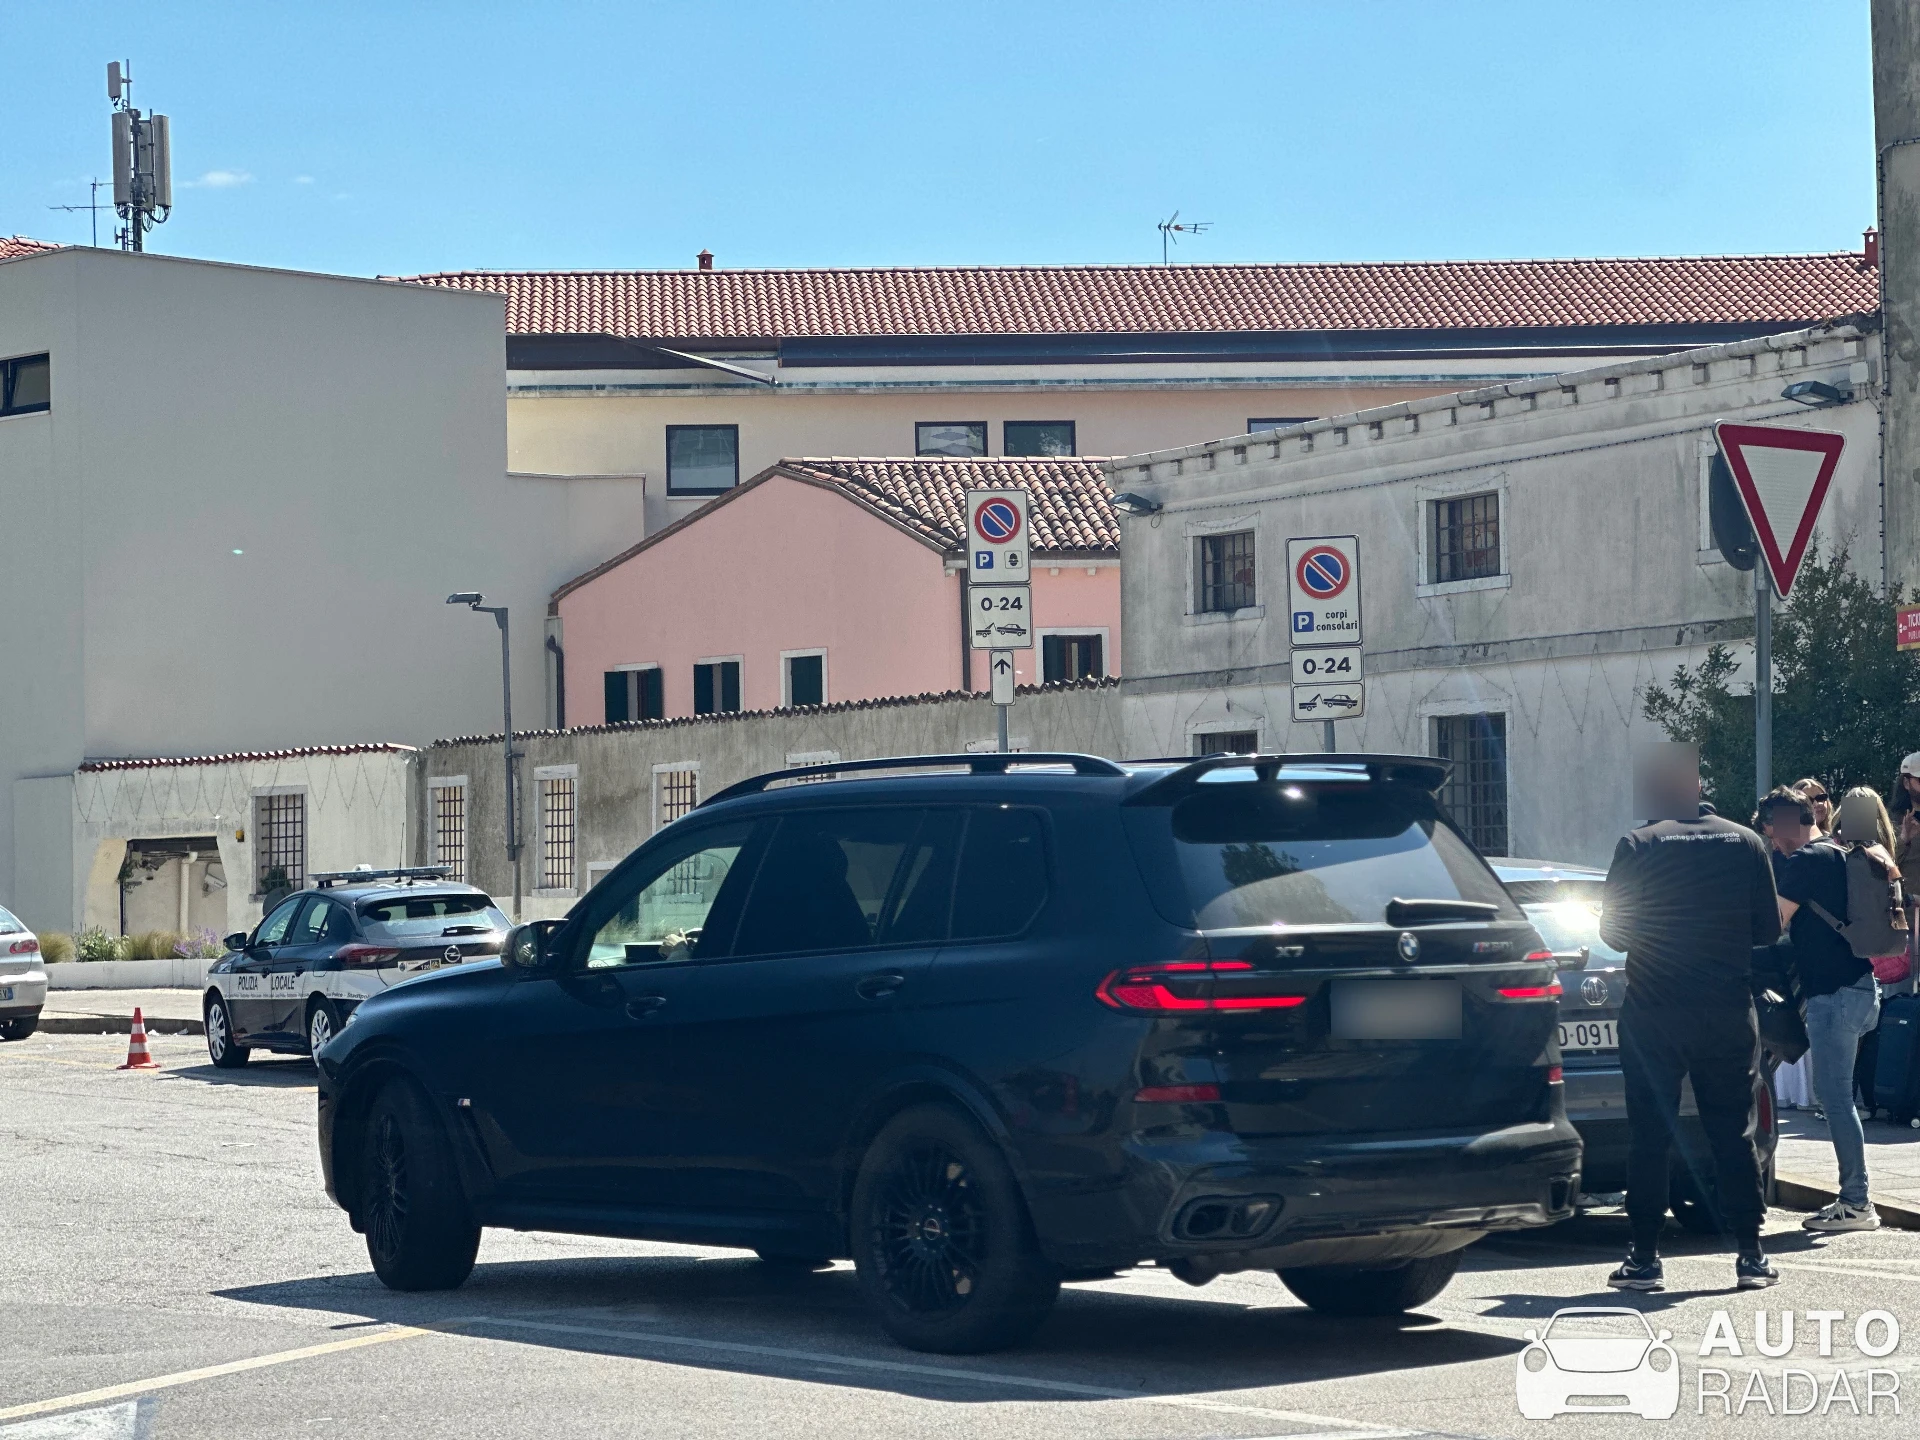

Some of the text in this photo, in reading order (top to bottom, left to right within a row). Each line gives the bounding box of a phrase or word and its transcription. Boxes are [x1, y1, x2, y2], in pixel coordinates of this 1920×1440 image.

[979, 554, 990, 567] P
[981, 597, 1023, 611] 0-24
[1325, 609, 1348, 621] corpi
[1298, 615, 1358, 631] P consolari
[1303, 657, 1352, 674] 0-24
[1275, 946, 1305, 958] X7
[237, 975, 296, 991] POLIZIA LOCALE
